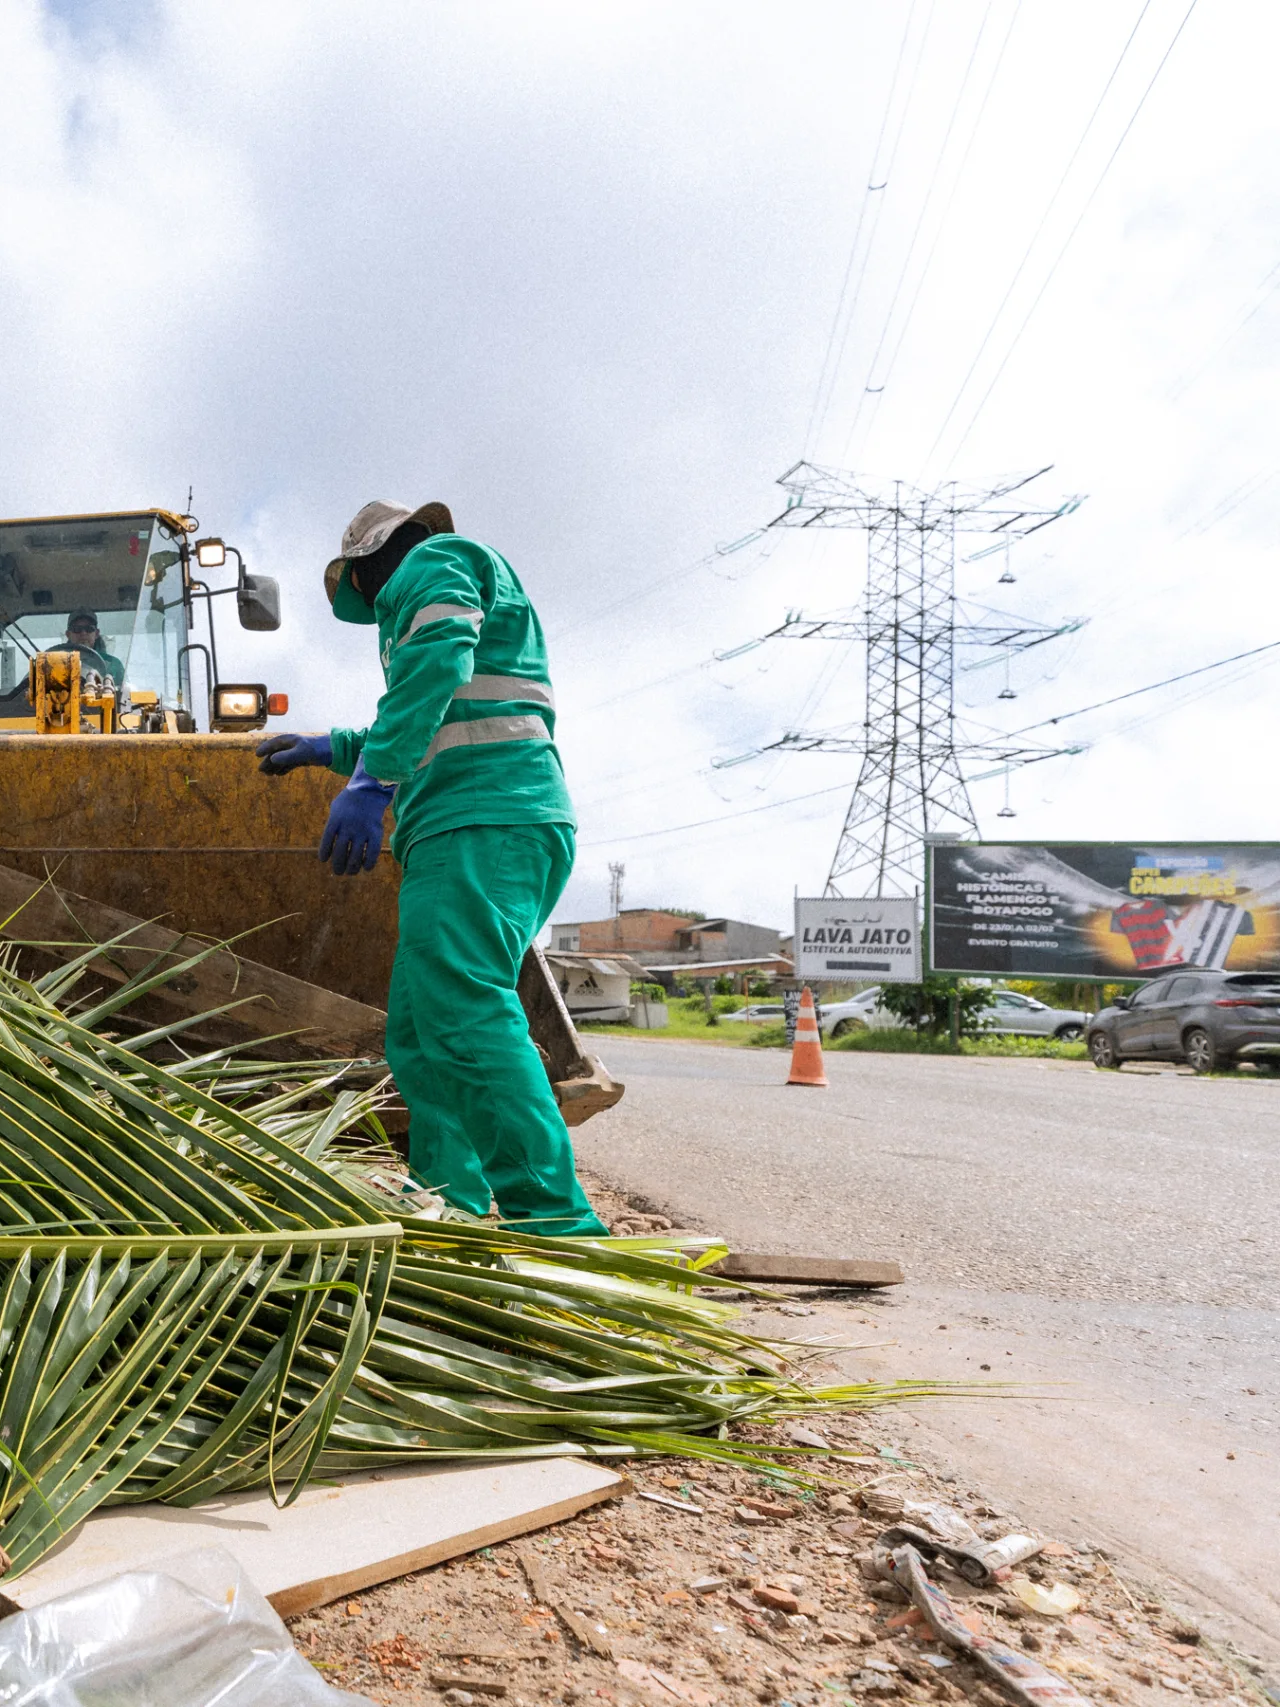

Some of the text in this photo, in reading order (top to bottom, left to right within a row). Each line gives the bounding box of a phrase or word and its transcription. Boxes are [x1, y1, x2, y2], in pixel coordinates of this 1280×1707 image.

[966, 894, 1060, 905] FLAMENGO E
[972, 906, 1053, 916] BOTAFOGO
[803, 927, 912, 945] LAVA JATO
[968, 938, 1059, 949] EVENTO GRATUITO
[847, 946, 913, 955] AUTOMOTIVA
